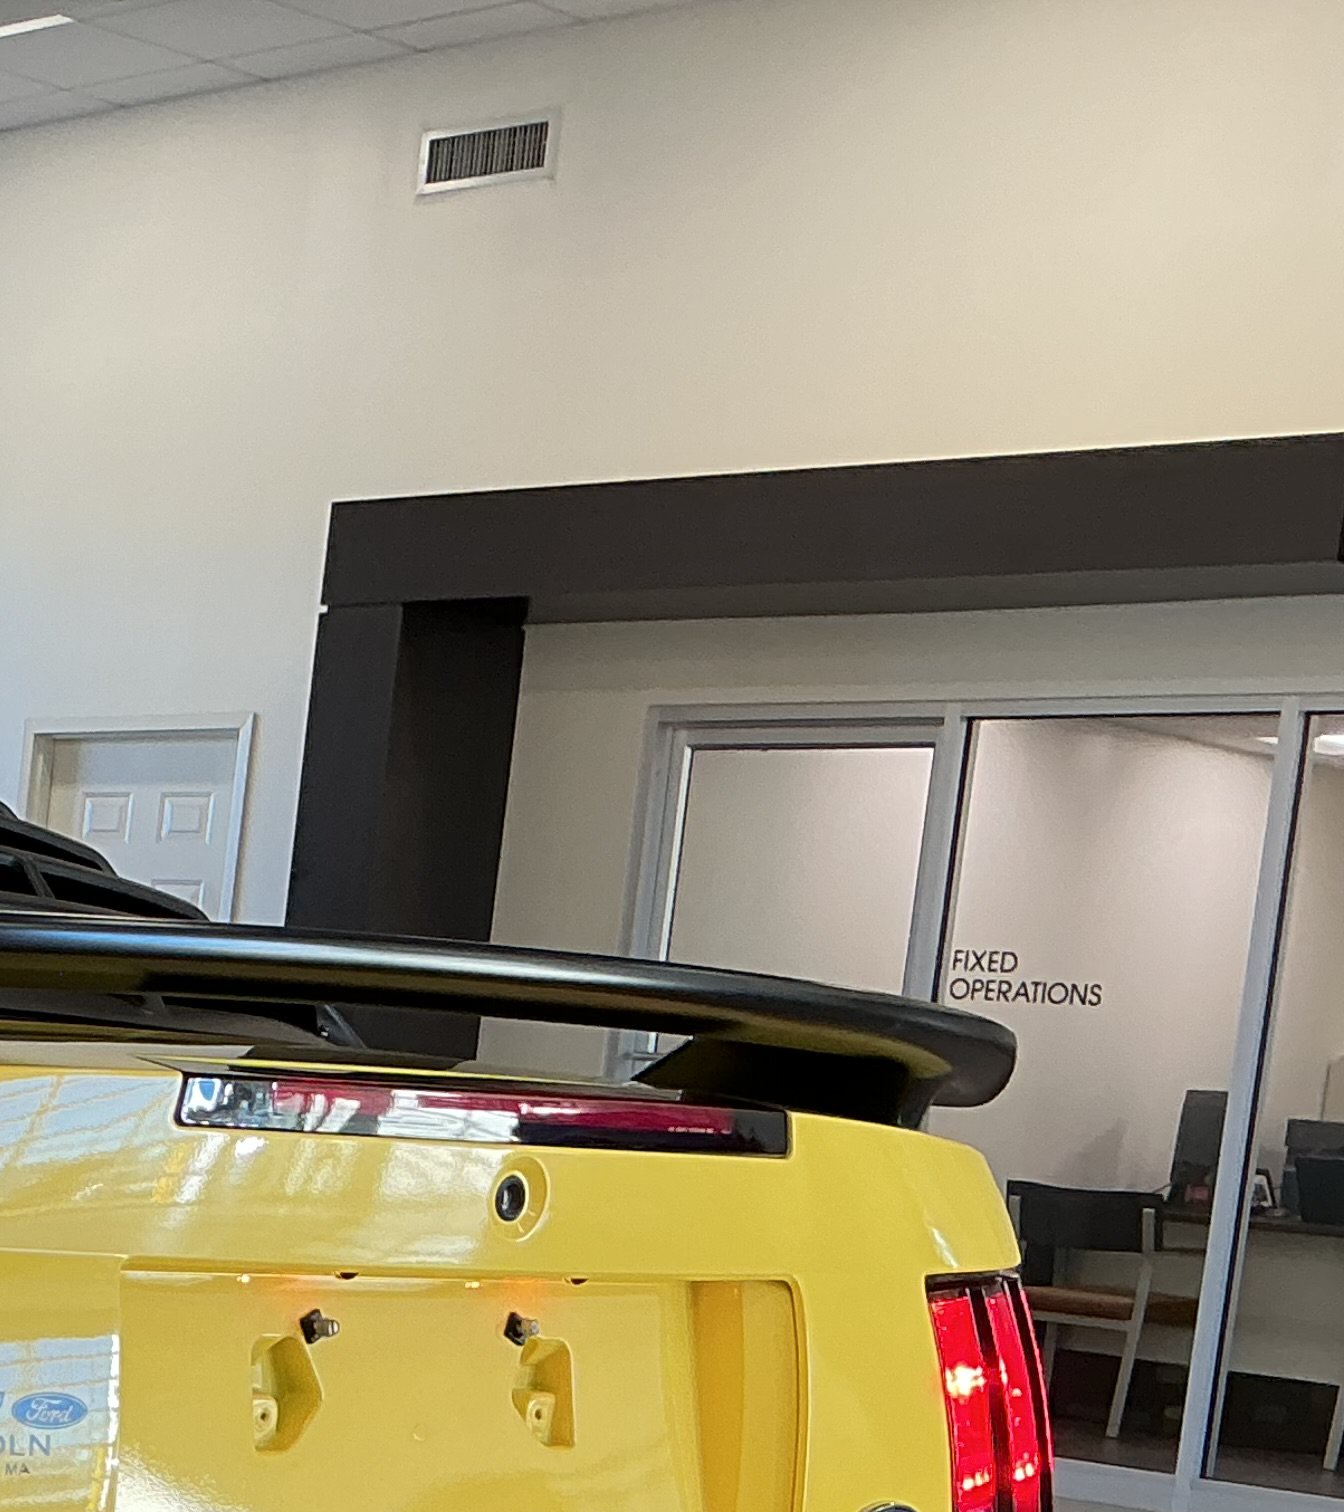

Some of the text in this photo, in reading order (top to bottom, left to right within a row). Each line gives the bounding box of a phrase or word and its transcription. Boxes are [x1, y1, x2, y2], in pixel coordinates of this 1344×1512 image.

[952, 949, 1018, 973] FIXED
[949, 978, 1102, 1006] OPERATIONS
[24, 1400, 73, 1424] Ford
[5, 1462, 31, 1476] MA
